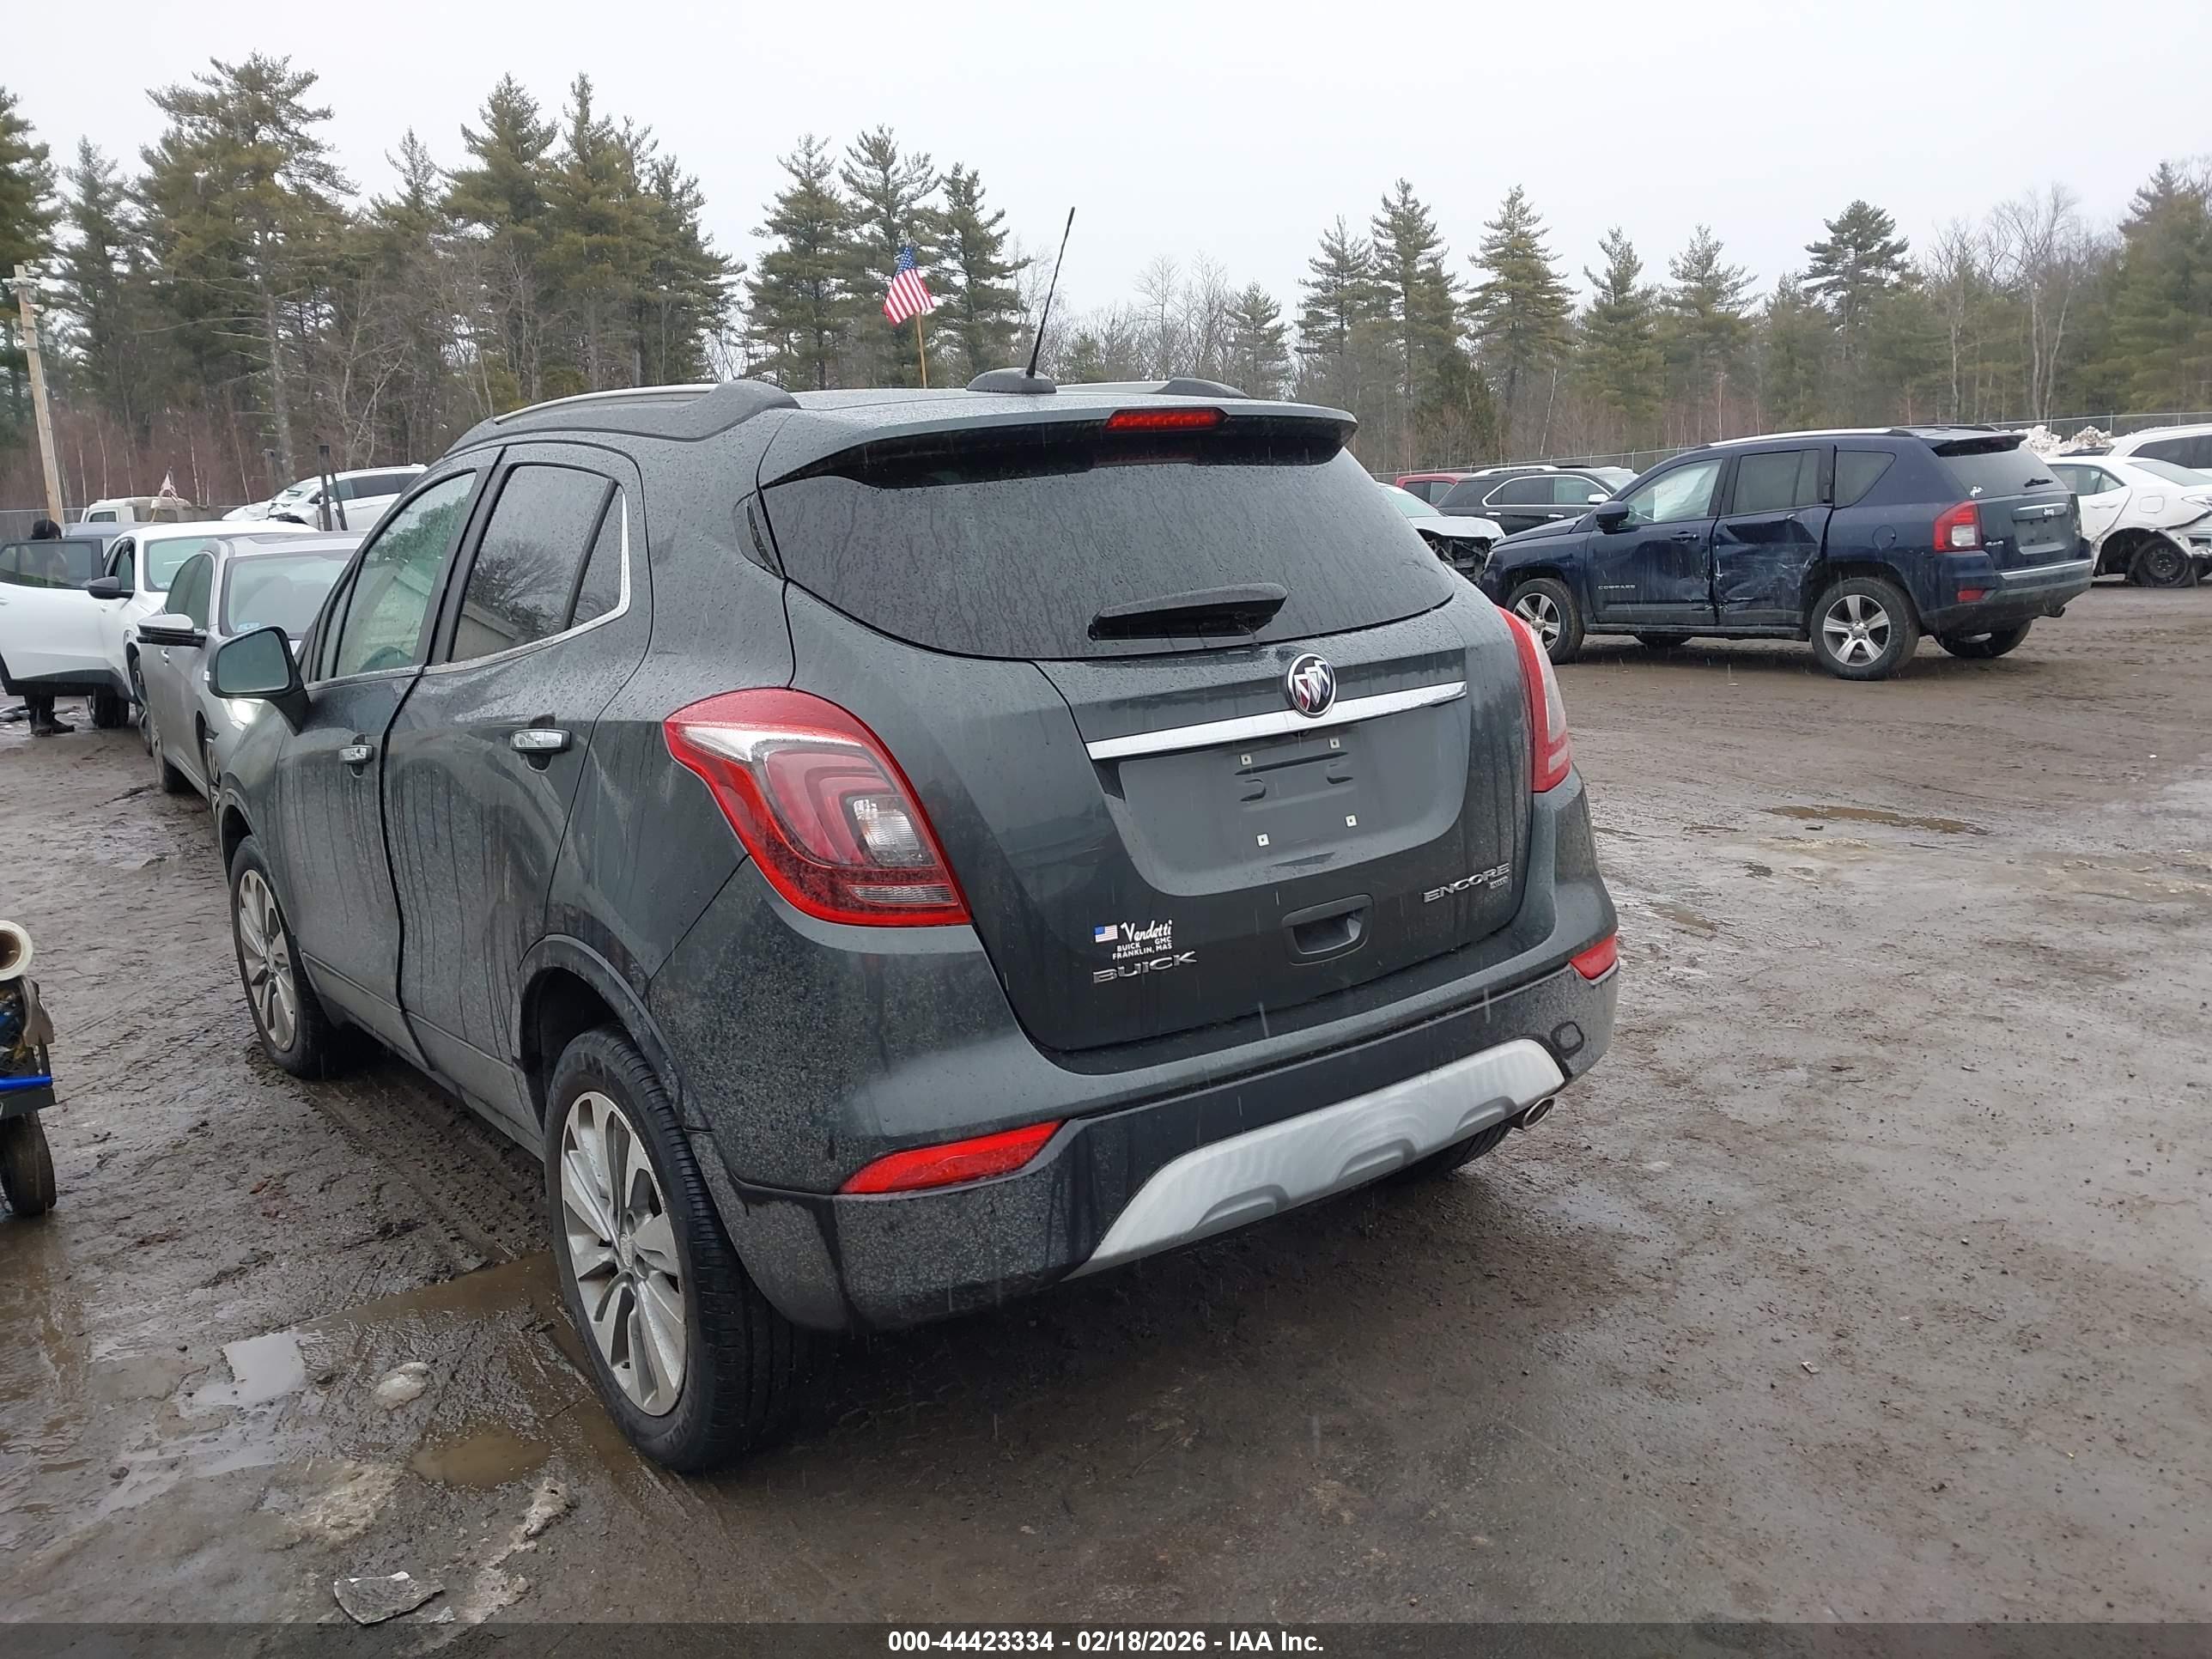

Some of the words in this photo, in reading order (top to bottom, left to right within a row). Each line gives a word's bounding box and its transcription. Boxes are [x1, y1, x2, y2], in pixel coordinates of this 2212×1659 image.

[1423, 862, 1510, 903] ENCORE
[1120, 919, 1173, 942] Vendetti
[1112, 946, 1155, 960] FRANKLIN,
[1155, 942, 1173, 952] MAS
[1116, 942, 1141, 952] BUICK
[1154, 936, 1172, 945] GMC
[1092, 951, 1197, 984] BUICK
